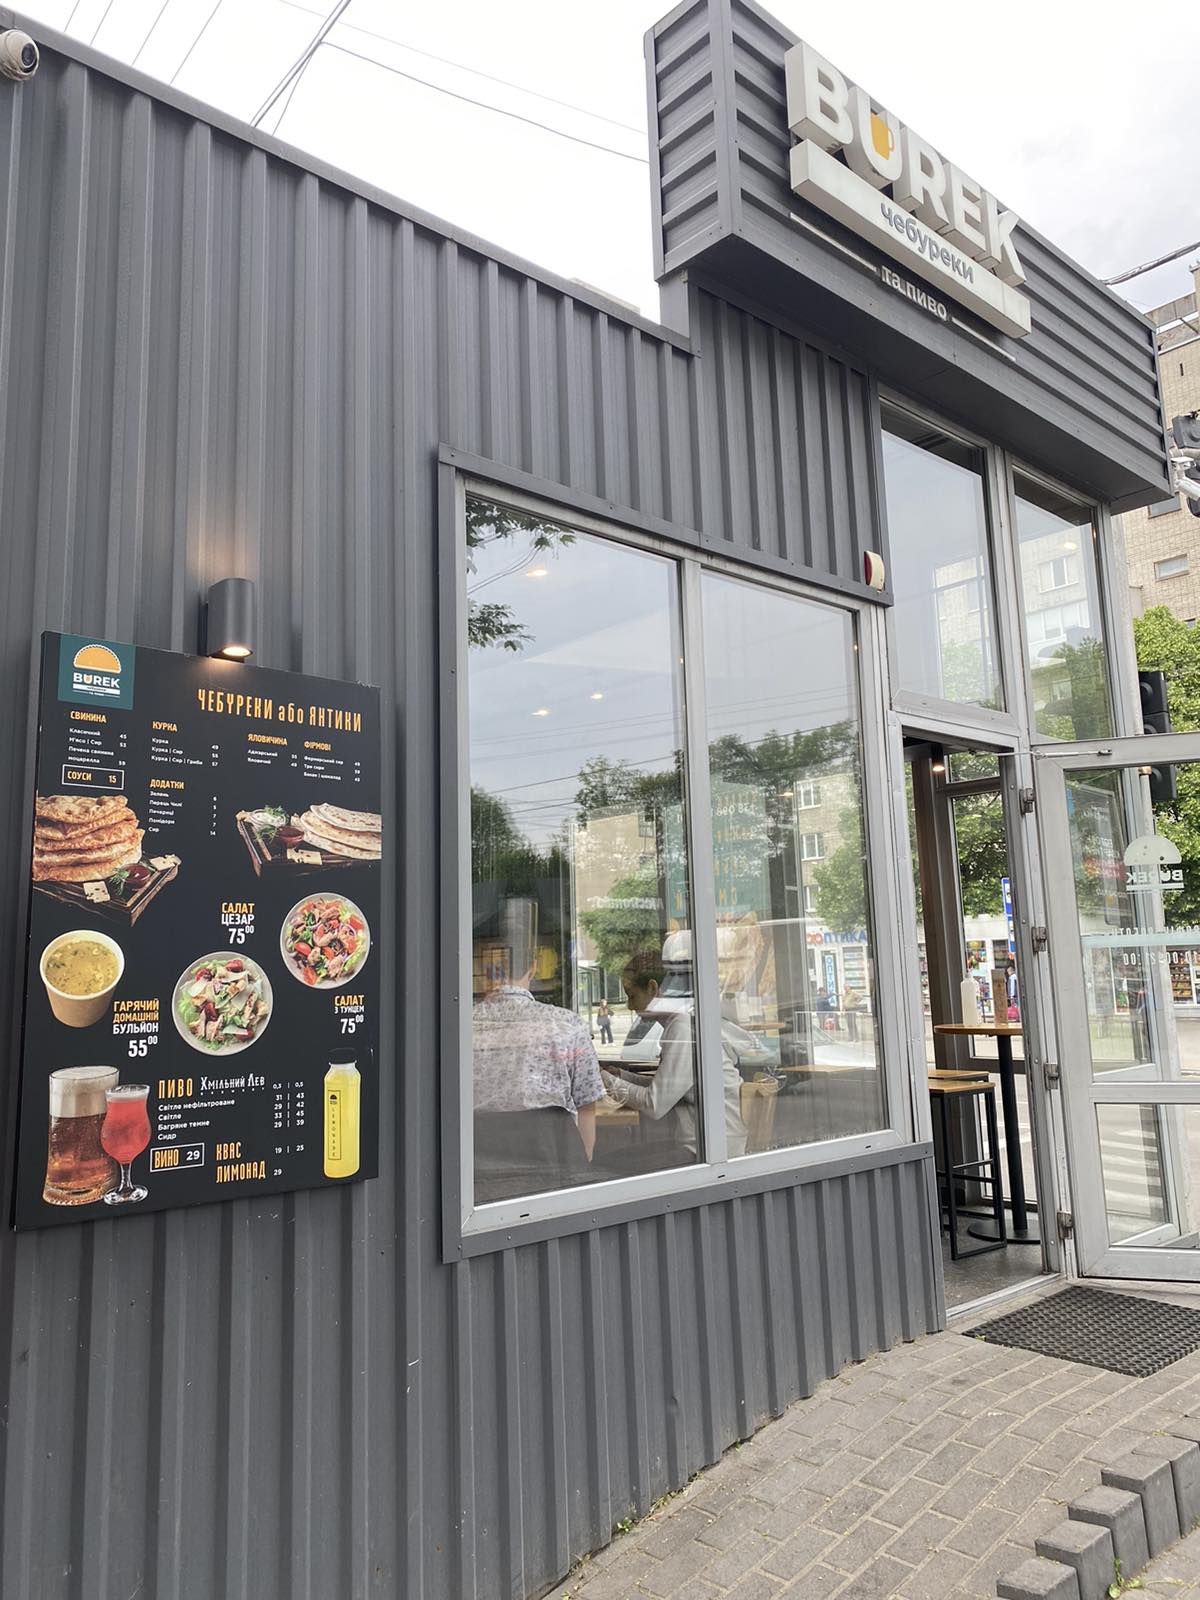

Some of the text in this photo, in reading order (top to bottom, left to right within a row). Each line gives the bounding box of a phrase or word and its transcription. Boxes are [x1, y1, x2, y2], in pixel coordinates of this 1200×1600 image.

[786, 40, 1026, 284] BUREK
[880, 202, 975, 284] чебуреки
[906, 276, 949, 322] пиво
[73, 672, 121, 689] BUREK
[70, 710, 107, 723] СВИНИНА
[197, 688, 361, 732] ЧЕБУРЕКИ або ЯНТИКИ
[152, 721, 178, 732] КУРКА
[247, 733, 288, 746] ЯЛОВИЧИНА
[67, 770, 117, 784] СОУСИ 15
[149, 778, 185, 790] ДОДАТКИ
[221, 902, 255, 914] САЛАТ
[221, 913, 255, 927] ЦЕЗАР
[113, 998, 160, 1012] ГАРЯЧИЙ
[334, 994, 365, 1006] САЛАТ
[112, 1011, 159, 1024] ДОМАШНІЙ
[112, 1022, 159, 1035] БУЛЬЙОН
[158, 1078, 193, 1099] ПИВО
[158, 1103, 182, 1112] Світле
[157, 1113, 182, 1121] Світле
[216, 1141, 242, 1161] КВАС
[154, 1149, 201, 1169] ВИНО 29
[216, 1160, 283, 1183] ЛИМОНАД 29
